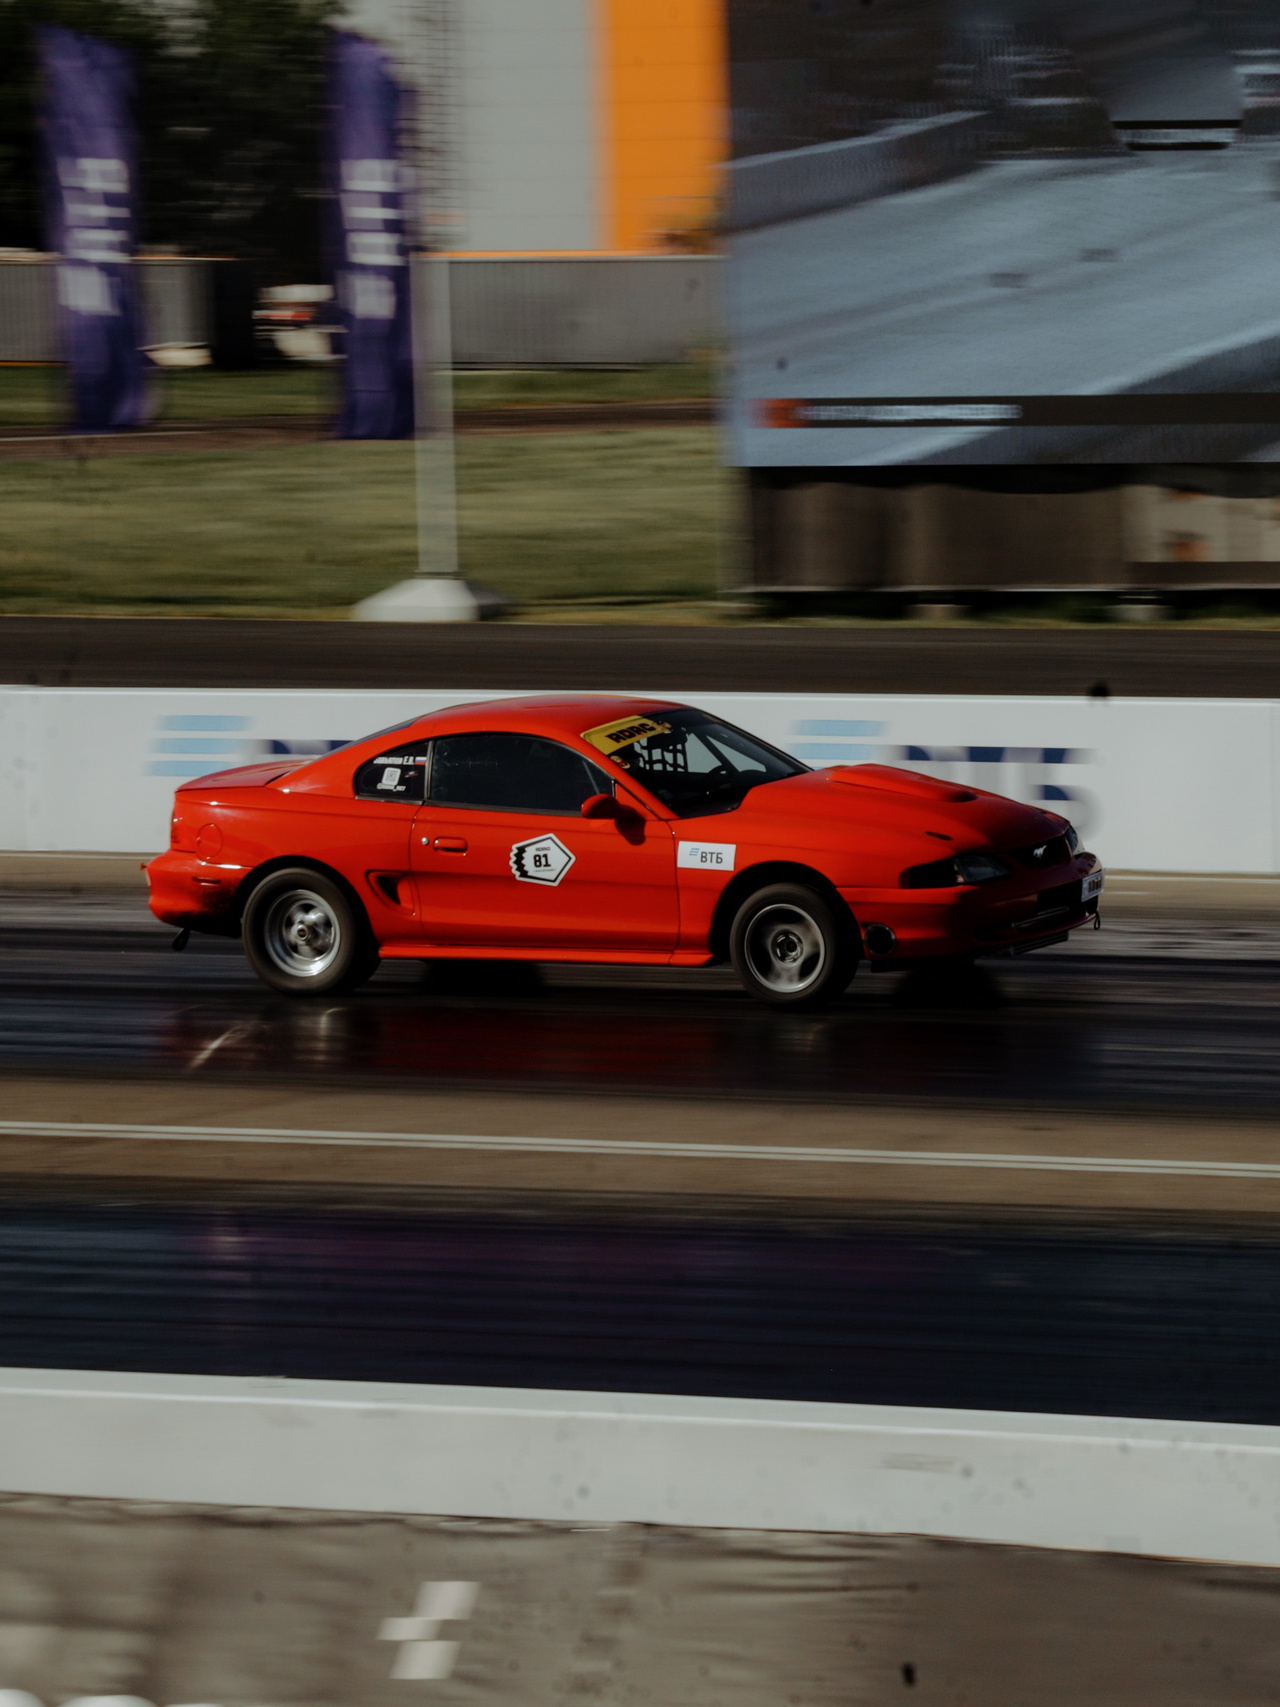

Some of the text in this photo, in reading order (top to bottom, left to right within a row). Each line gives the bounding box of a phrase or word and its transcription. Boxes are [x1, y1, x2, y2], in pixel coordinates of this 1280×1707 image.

[605, 722, 656, 743] RDRC
[533, 853, 551, 868] 81
[700, 851, 723, 864] ВТБ
